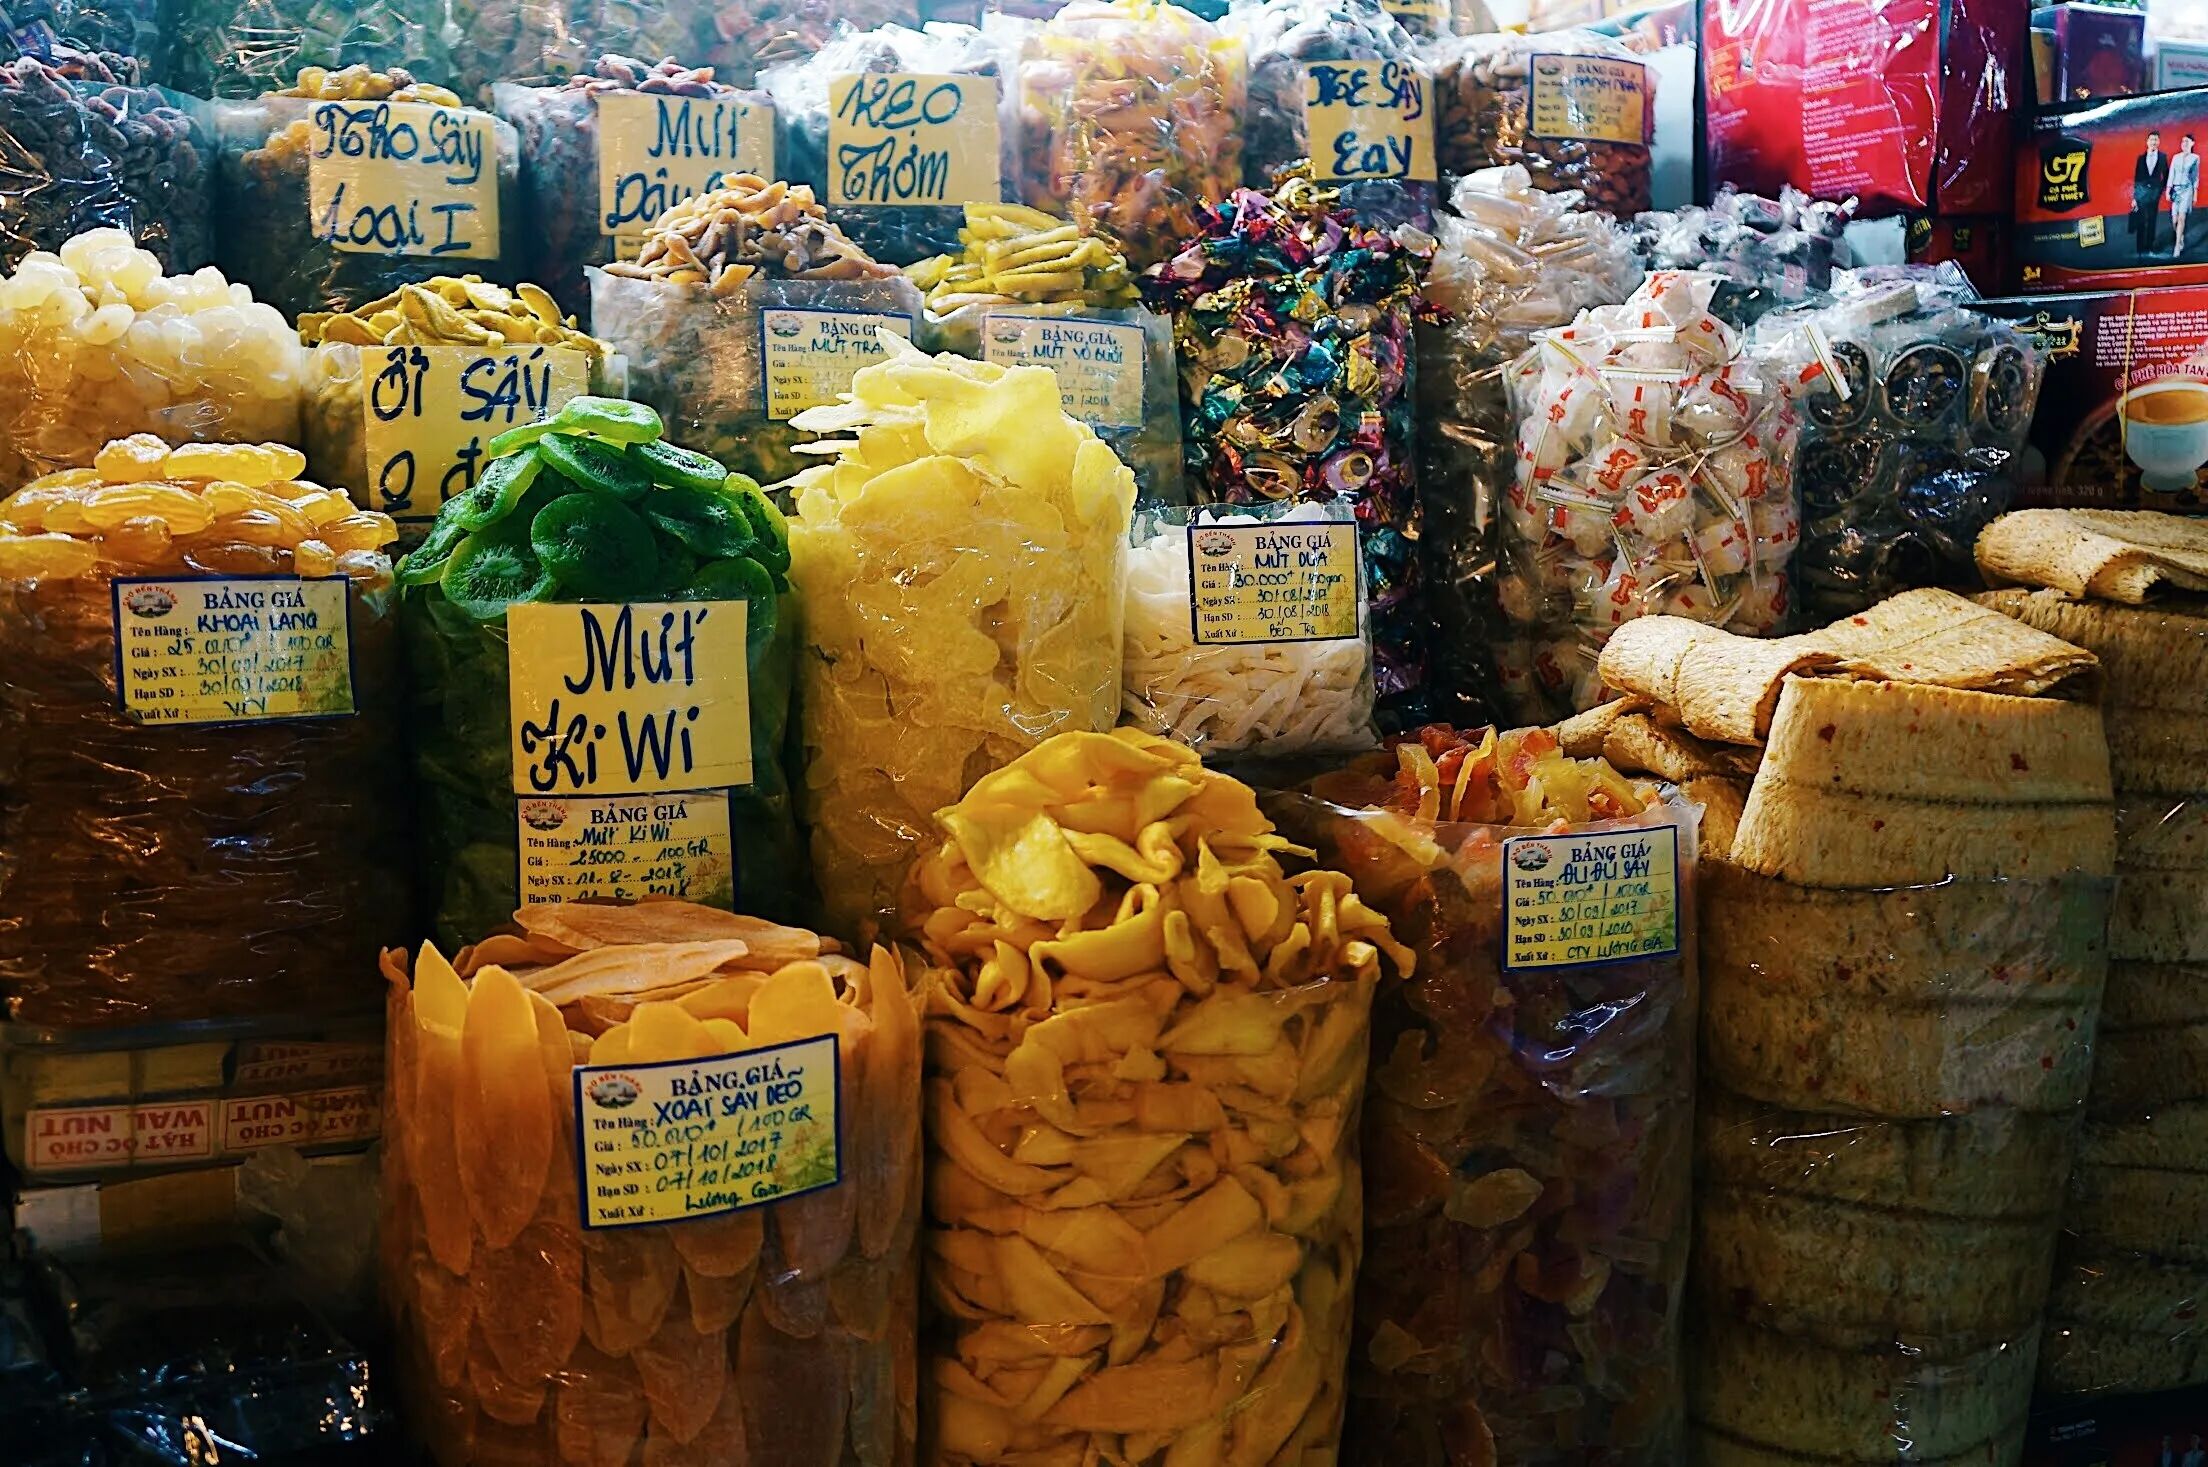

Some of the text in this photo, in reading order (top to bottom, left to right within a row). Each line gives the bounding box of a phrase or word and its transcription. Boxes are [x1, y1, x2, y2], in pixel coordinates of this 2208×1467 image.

[820, 317, 859, 336] BẢNG
[1042, 325, 1083, 342] BẢNG
[772, 344, 787, 352] Tên
[772, 359, 786, 368] Giá
[773, 376, 802, 385] Ngày SX
[791, 391, 800, 400] SD
[1255, 531, 1331, 549] BẢNG GIÁ
[1201, 563, 1217, 573] Tên
[1202, 579, 1215, 589] Giá
[203, 586, 305, 609] BẢNG GIÁ
[1202, 597, 1222, 607] Ngày
[1203, 613, 1221, 623] Hạn
[1222, 613, 1233, 622] SD
[130, 626, 151, 637] Tên
[154, 626, 182, 639] Hàng
[1204, 629, 1223, 638] Xuất
[1225, 628, 1238, 638] Xứ
[131, 647, 151, 658] Giá
[133, 667, 159, 680] Ngày
[161, 666, 177, 678] SX
[134, 688, 157, 700] Hạn
[158, 687, 174, 698] SD
[135, 708, 161, 720] Xuất
[163, 707, 179, 719] Xứ
[591, 799, 688, 824] BẢNG GIÁ
[527, 838, 546, 848] Tên
[548, 837, 571, 850] Hàng
[1571, 839, 1646, 862] BẢNG GIÁ
[527, 856, 543, 866] Giá
[528, 875, 565, 887] Ngày SX
[1515, 879, 1531, 888] Tên
[1533, 878, 1554, 889] Hàng
[548, 893, 562, 903] SD
[1516, 898, 1530, 907] Giá
[1515, 916, 1535, 926] Ngày
[1536, 915, 1549, 924] SX
[1515, 934, 1534, 943] Hạn
[1535, 933, 1546, 943] SD
[1515, 952, 1534, 962] Xuất
[1536, 952, 1549, 961] Xứ
[671, 1057, 785, 1097] BẢNG GIÁ
[231, 1100, 297, 1123] NUT
[39, 1110, 206, 1137] WAL NUT
[593, 1118, 615, 1130] Tên
[618, 1117, 648, 1131] Hàng
[145, 1131, 196, 1149] HẠT
[594, 1140, 615, 1153] Giá
[596, 1162, 624, 1176] Ngày
[625, 1159, 643, 1173] SX
[597, 1186, 620, 1197] Hạn
[622, 1184, 639, 1196] SD
[599, 1207, 625, 1220] Xuất
[627, 1205, 644, 1217] Xứ
